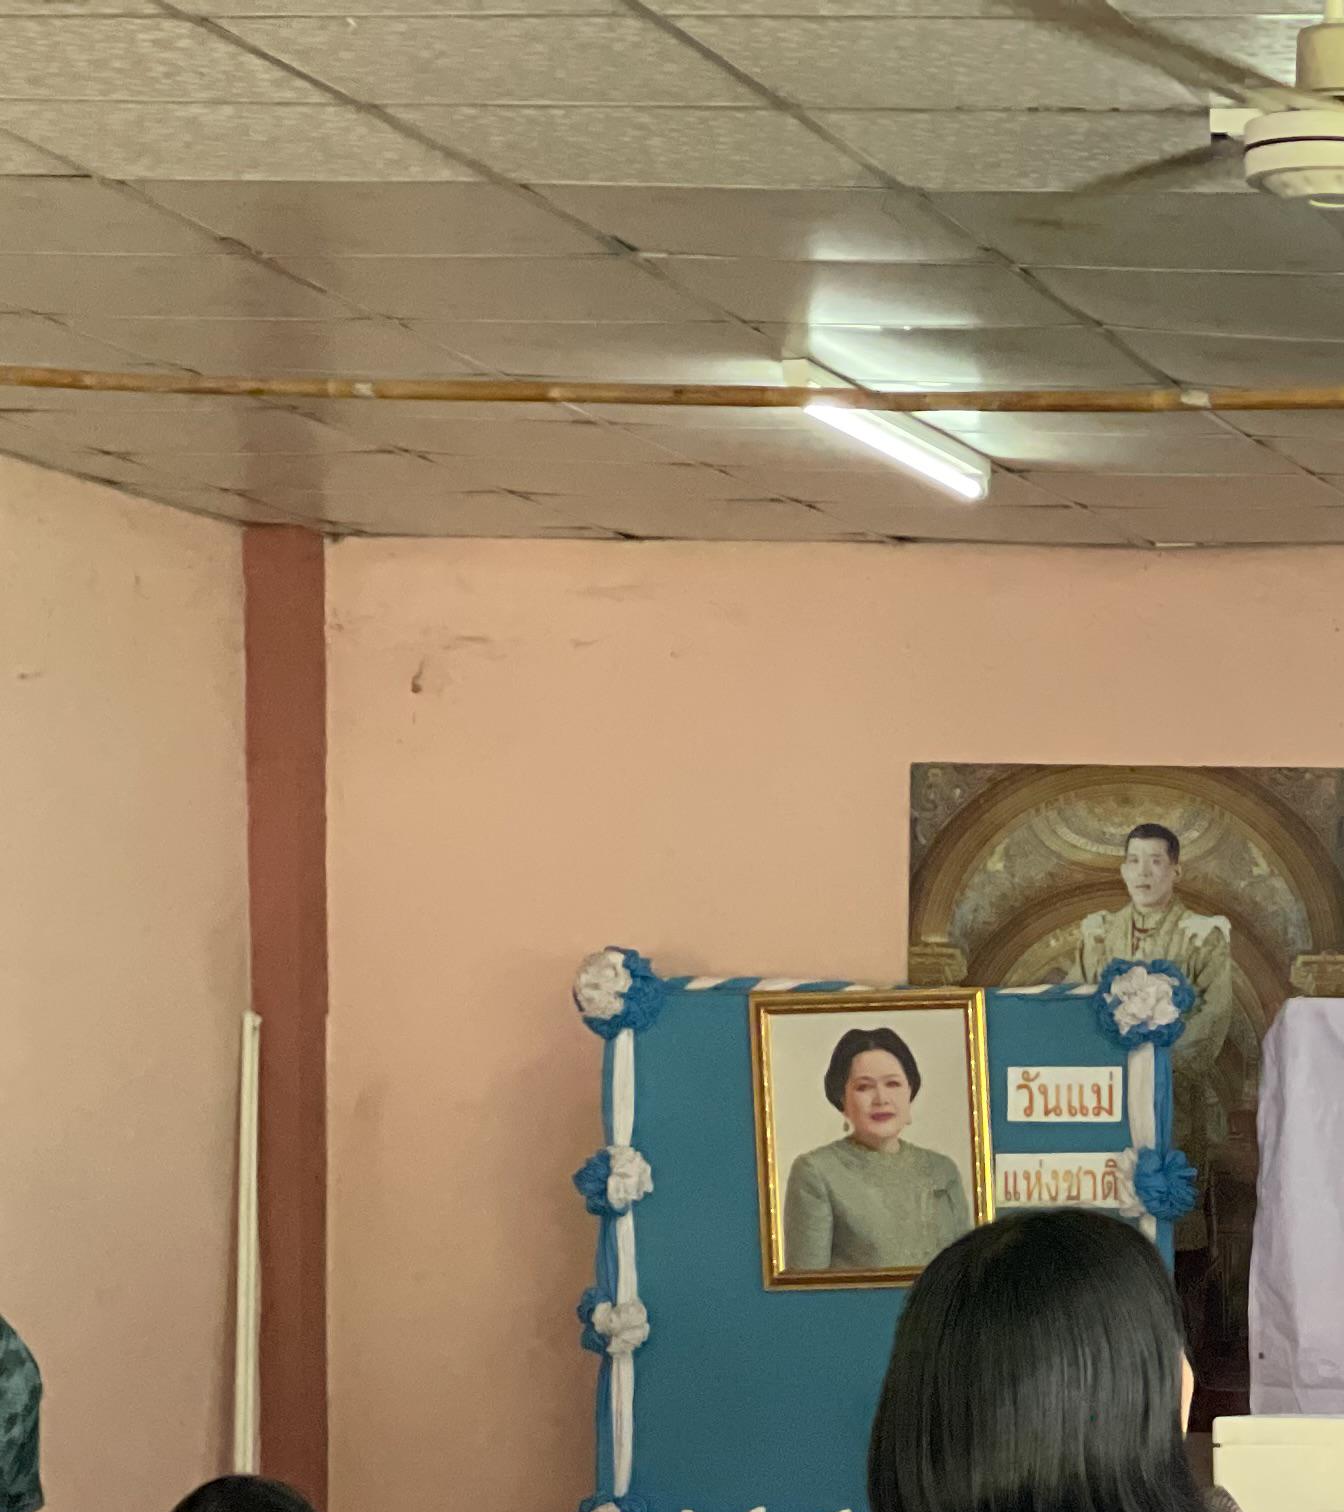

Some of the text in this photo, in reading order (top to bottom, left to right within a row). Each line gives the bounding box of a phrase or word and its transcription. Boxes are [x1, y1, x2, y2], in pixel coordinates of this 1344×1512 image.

[1016, 1071, 1114, 1117] วันแม่
[1004, 1159, 1118, 1201] แห่งชาติ
